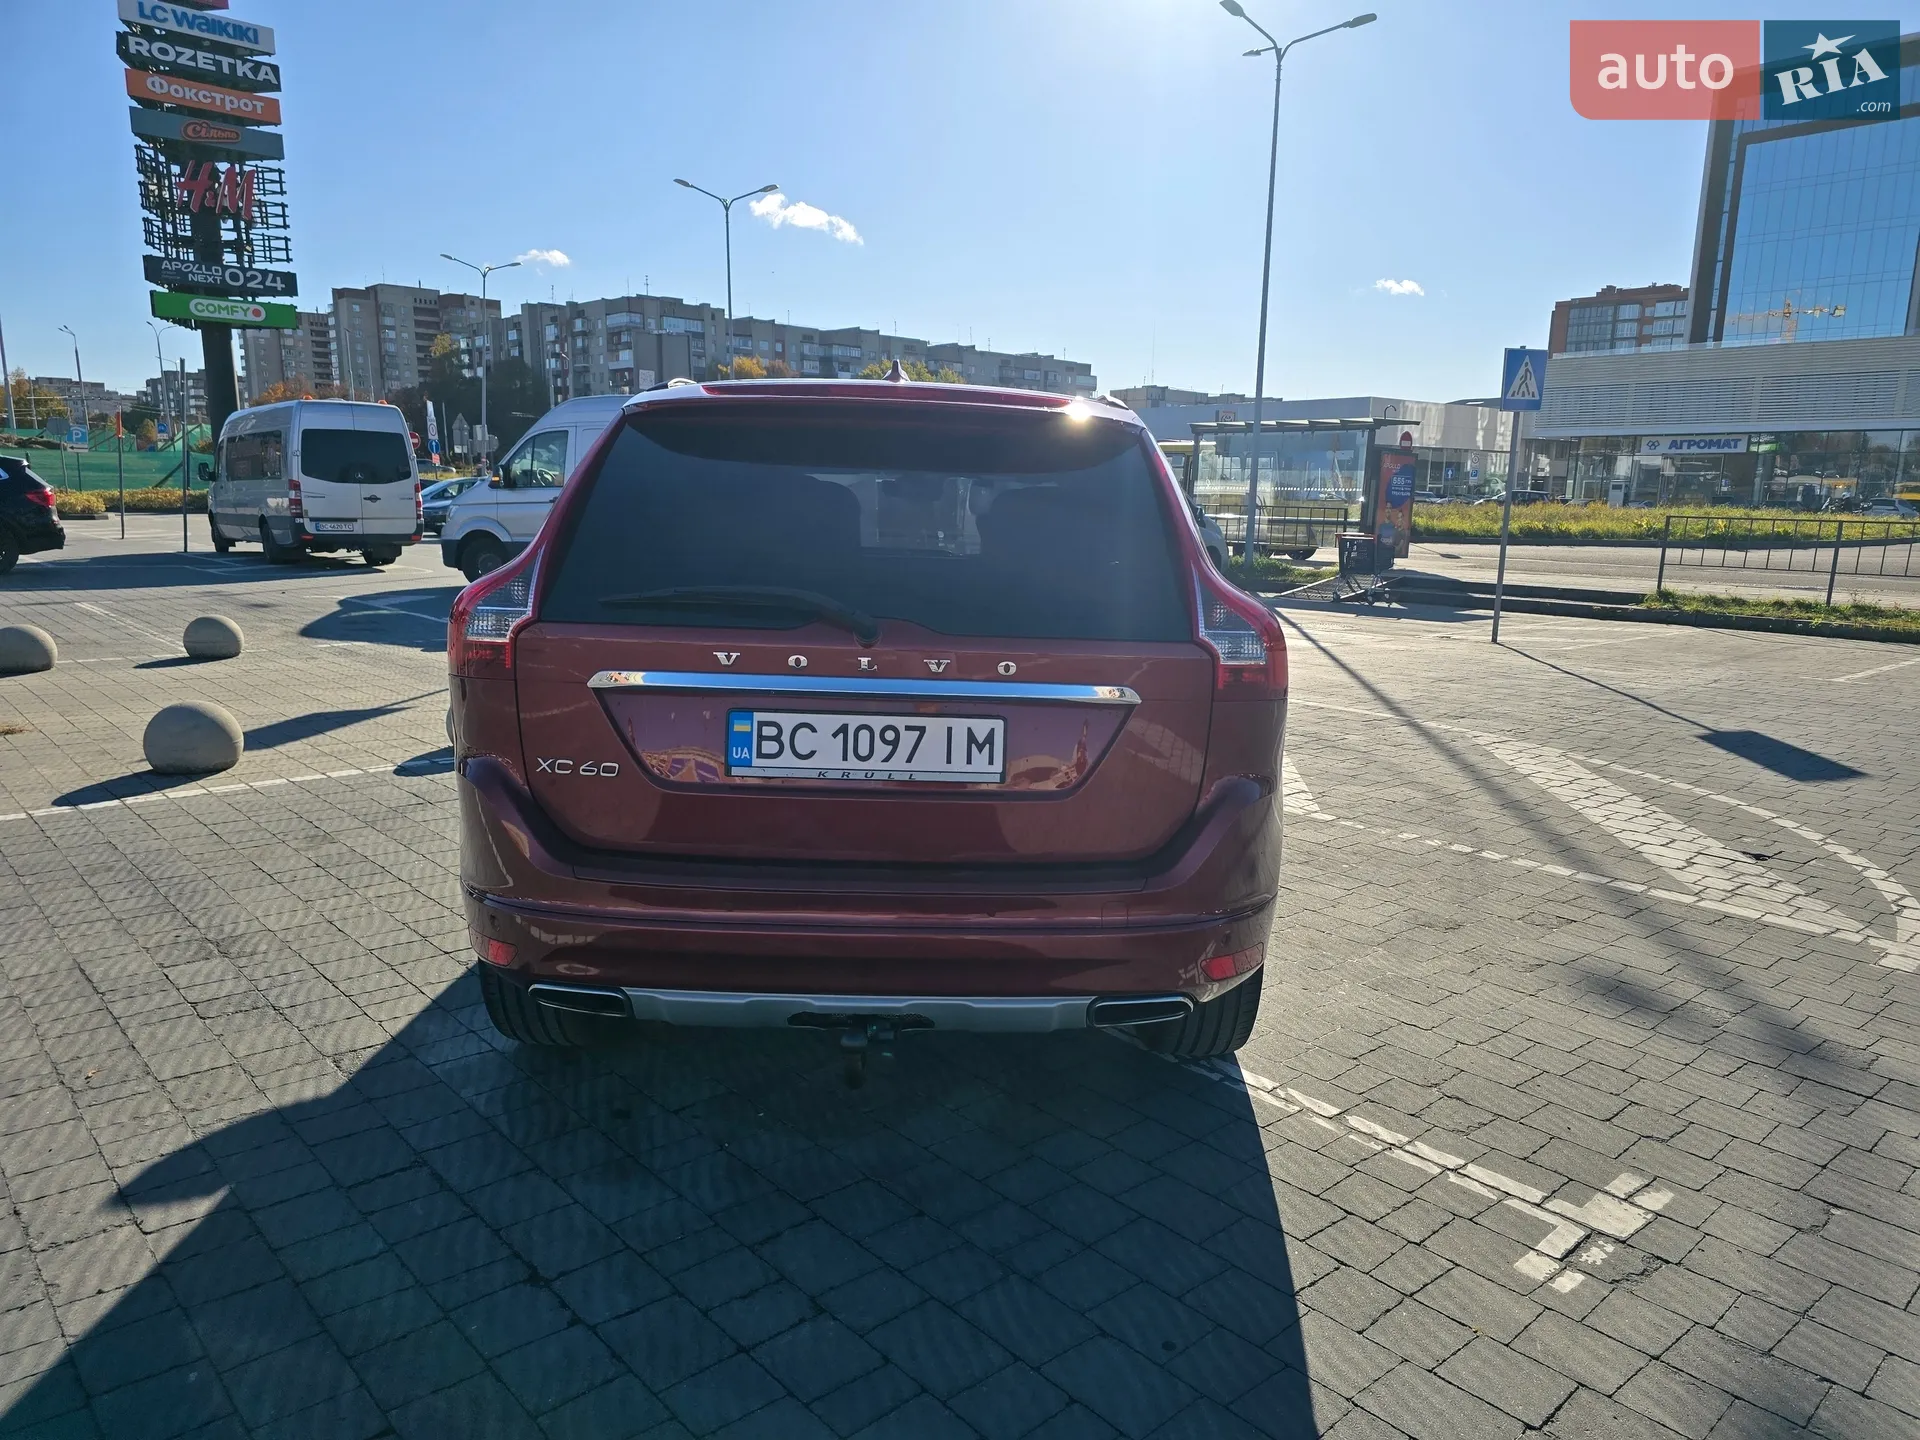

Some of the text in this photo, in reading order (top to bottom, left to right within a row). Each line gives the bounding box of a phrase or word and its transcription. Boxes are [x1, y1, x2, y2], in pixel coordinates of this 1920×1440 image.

[137, 0, 169, 24] LC
[127, 35, 279, 85] ROZETKA
[146, 76, 265, 115] Фокстрот
[175, 160, 256, 221] H&M
[161, 260, 223, 276] APOLLO
[188, 273, 223, 285] NEXT
[225, 268, 286, 291] 024
[194, 301, 251, 318] COMFY
[72, 430, 82, 442] P
[1668, 438, 1742, 450] АГРОМАТ
[713, 651, 1017, 676] VOLVO
[732, 746, 751, 759] UA
[756, 720, 996, 766] BC 1097 IM
